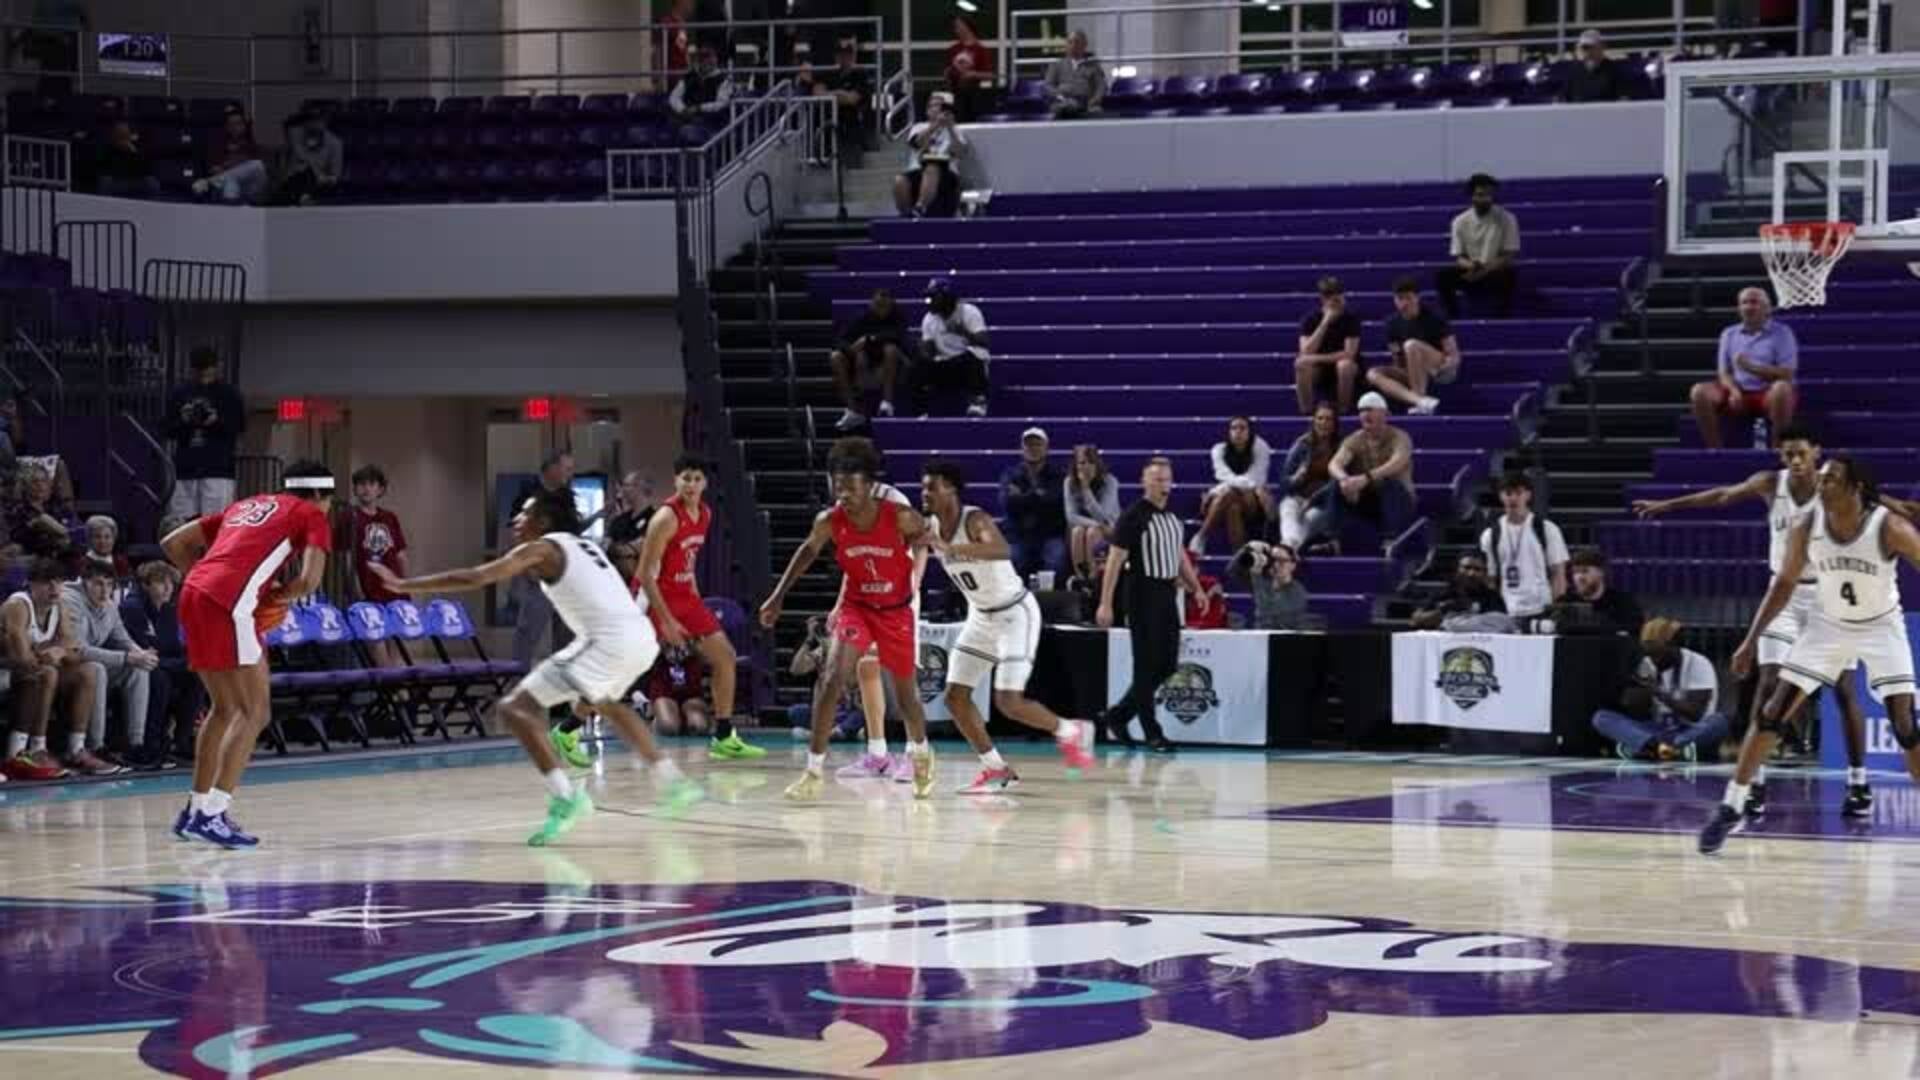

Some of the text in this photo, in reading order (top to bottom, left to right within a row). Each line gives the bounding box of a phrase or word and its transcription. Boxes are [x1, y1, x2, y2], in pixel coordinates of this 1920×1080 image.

[1368, 8, 1396, 26] 101
[123, 41, 154, 58] 120
[224, 500, 279, 527] 23
[951, 570, 979, 591] 10
[1840, 580, 1857, 606] 4
